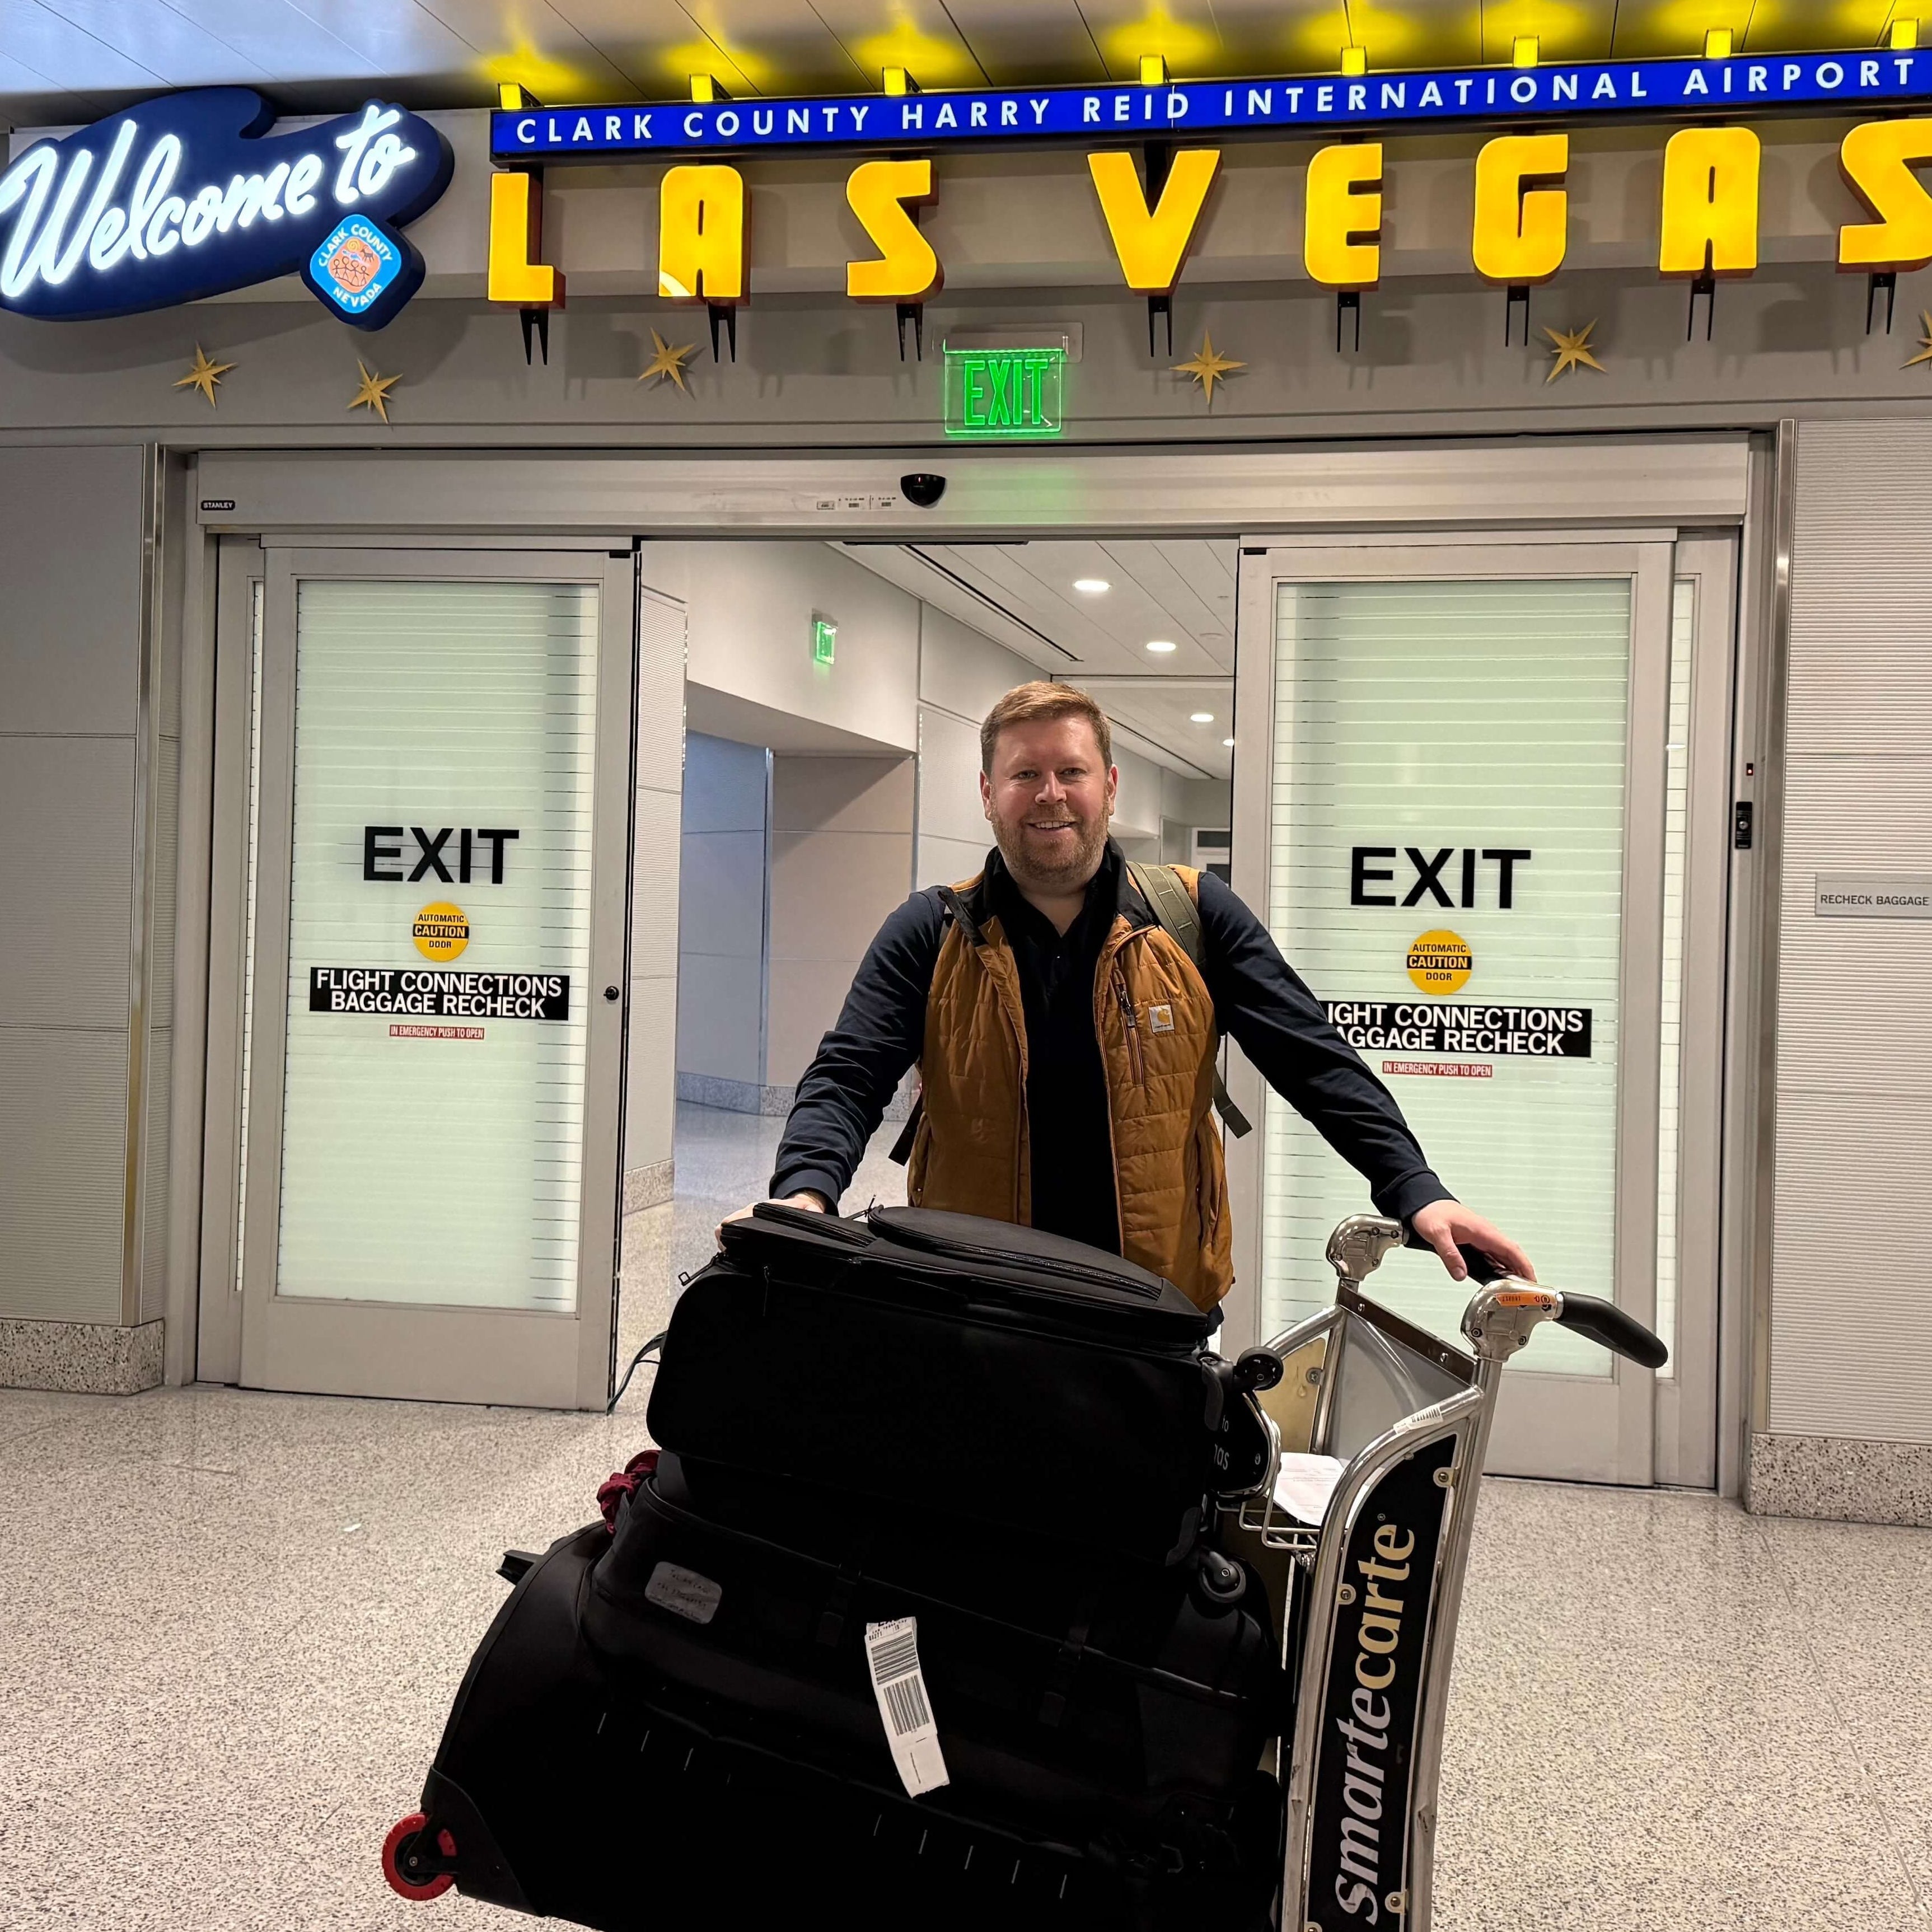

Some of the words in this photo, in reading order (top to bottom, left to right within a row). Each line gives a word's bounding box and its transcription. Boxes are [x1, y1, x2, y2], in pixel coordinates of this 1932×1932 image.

[517, 114, 652, 144] CLARK
[684, 106, 869, 138] COUNTY
[902, 99, 1049, 129] HARRY
[1083, 92, 1189, 122] REID
[1224, 71, 1647, 116] INTERNATIONAL
[1683, 58, 1914, 95] AIRPORT
[0, 119, 323, 297] Welcome
[334, 104, 416, 204] to
[488, 159, 937, 302] LAS
[1087, 119, 1932, 289] VEGAS
[319, 227, 349, 267] CLARK
[350, 223, 393, 261] COUNTY
[333, 283, 382, 307] NEVADA
[964, 359, 1048, 425] EXIT
[363, 826, 520, 884] EXIT
[1351, 847, 1531, 909] EXIT
[1821, 895, 1873, 905] RECHECK
[1876, 896, 1930, 906] BAGGAGE
[415, 925, 466, 937] CAUTION
[418, 914, 464, 923] AUTOMATIC
[1412, 944, 1466, 953] AUTOMATIC
[1409, 956, 1468, 969] CAUTION
[317, 969, 394, 991] FLIGHT
[400, 972, 562, 997] CONNECTIONS
[1426, 972, 1452, 981] DOOR
[331, 991, 436, 1014] BAGGAGE
[442, 995, 546, 1017] RECHECK
[1328, 1003, 1387, 1025] IGHT
[1395, 1005, 1583, 1032] CONNECTIONS
[391, 1026, 397, 1035] IN
[399, 1026, 437, 1037] EMERGENCY
[438, 1027, 455, 1037] PUSH
[457, 1028, 465, 1037] TO
[466, 1028, 483, 1038] OPEN
[1444, 1030, 1565, 1055] RECHECK
[1384, 1063, 1392, 1072] IN
[1393, 1063, 1437, 1074] EMERGENCY
[1439, 1064, 1458, 1075] PUSH
[1460, 1065, 1469, 1075] TO
[1471, 1065, 1491, 1076] OPEN
[1335, 1523, 1415, 1926] smartecarte
